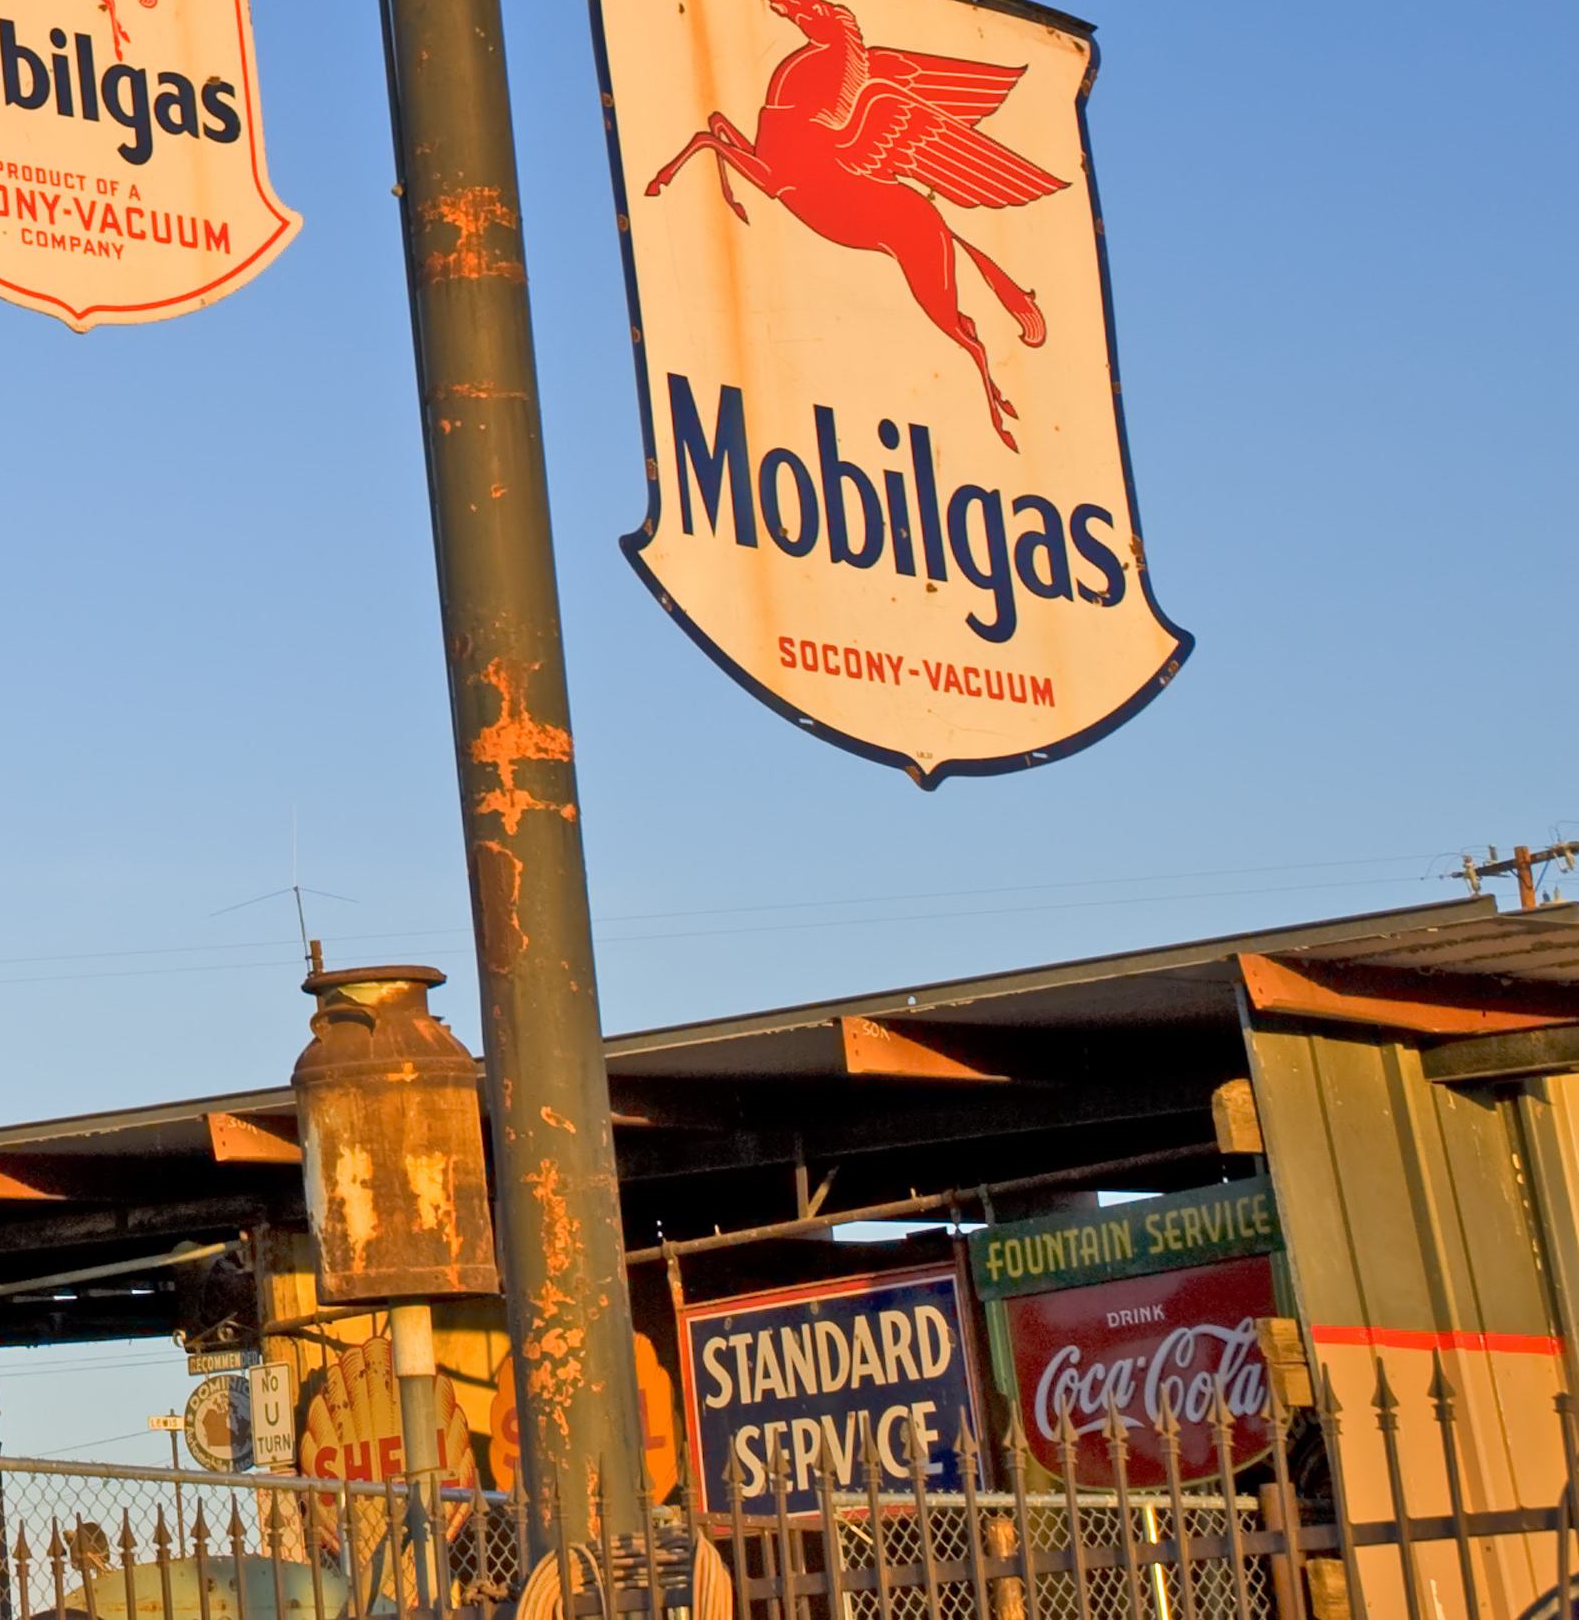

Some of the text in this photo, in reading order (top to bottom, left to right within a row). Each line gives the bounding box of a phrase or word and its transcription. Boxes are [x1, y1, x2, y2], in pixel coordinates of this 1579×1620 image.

[96, 178, 120, 198] OF
[128, 183, 141, 201] A
[21, 228, 124, 261] COMPANY
[666, 372, 1127, 643] Mobilgas
[779, 636, 1056, 708] SOCONY-VACUUM
[985, 1192, 1273, 1282] FOUNTAIN SERVICE
[1106, 1303, 1166, 1327] DRINK
[261, 1376, 278, 1392] NO
[702, 1304, 952, 1409] STANDARD
[1035, 1317, 1268, 1441] Coca-Cola
[257, 1433, 291, 1454] TURN
[265, 1401, 279, 1426] U
[735, 1400, 943, 1498] SERVICE
[315, 1428, 461, 1506] SHEL
